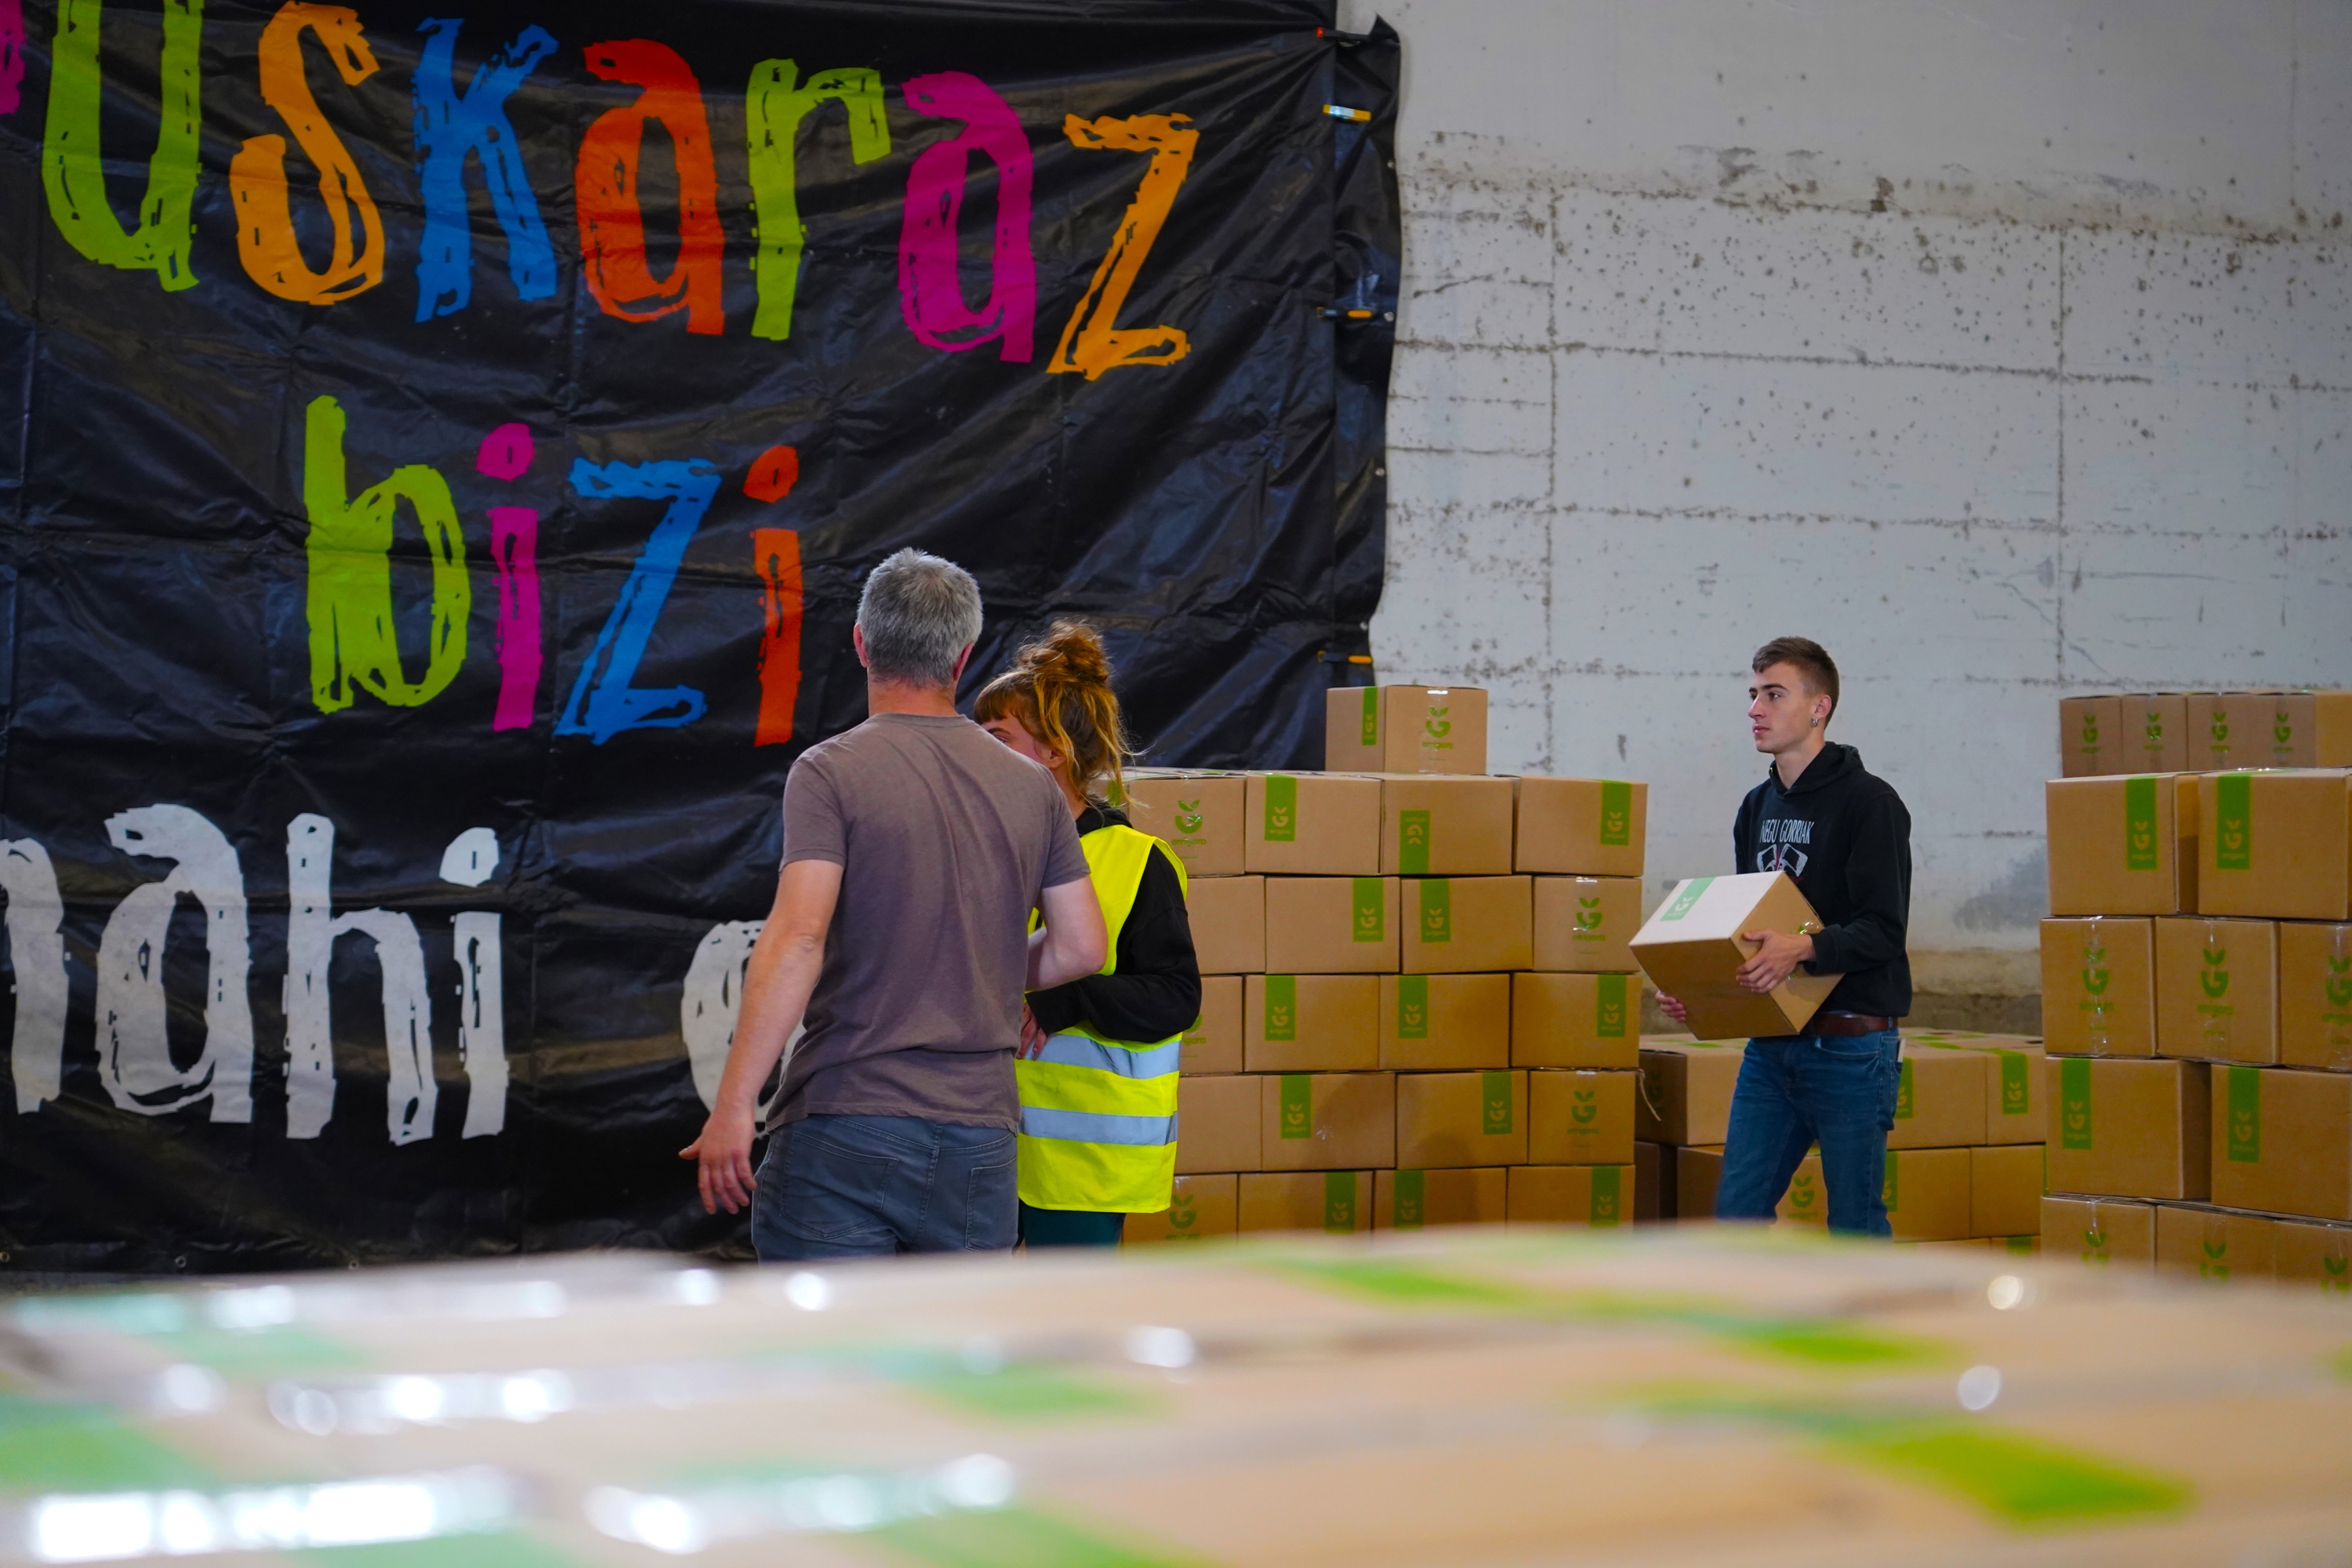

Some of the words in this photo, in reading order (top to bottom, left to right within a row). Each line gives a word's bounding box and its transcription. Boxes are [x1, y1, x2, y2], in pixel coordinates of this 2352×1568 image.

[0, 0, 1199, 380] uskaraz
[304, 394, 804, 747] bizi
[1759, 819, 1780, 844] NEGU
[1779, 819, 1815, 844] GORRIAK
